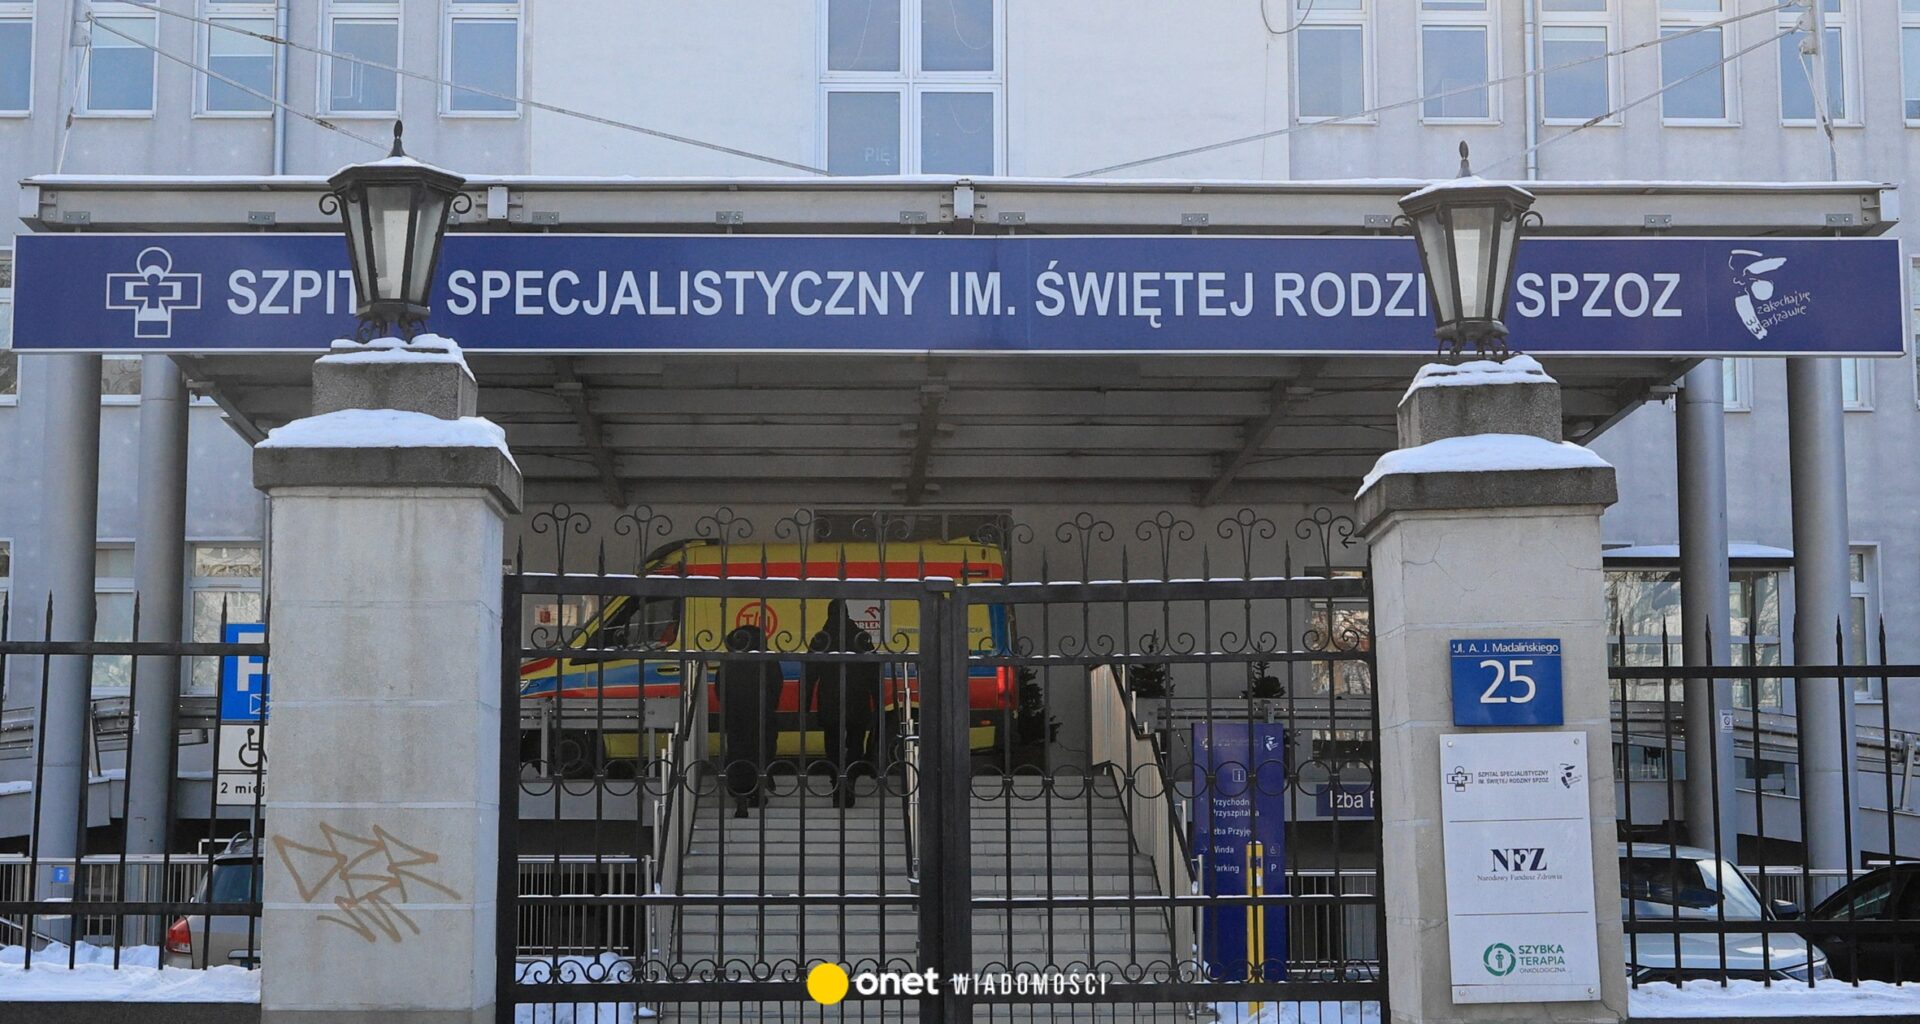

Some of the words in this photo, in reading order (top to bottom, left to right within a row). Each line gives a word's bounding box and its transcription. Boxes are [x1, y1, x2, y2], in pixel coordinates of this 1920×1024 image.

[227, 269, 358, 316] SZPIT
[446, 269, 924, 317] SPECJALISTYCZNY
[950, 270, 1016, 316] IM.
[1035, 260, 1255, 329] ŚWIĘTEJ
[1274, 271, 1428, 318] RODZI
[1515, 271, 1683, 318] SPZOZ
[1469, 643, 1480, 653] A.
[1483, 643, 1490, 653] J.
[1492, 642, 1559, 655] Madalińskiego
[1479, 659, 1536, 704] 25
[219, 781, 229, 794] 2
[1329, 790, 1364, 808] Izba
[1213, 809, 1260, 818] rzyszpitala
[1214, 827, 1227, 836] zba
[1228, 827, 1251, 837] Przyję
[1490, 848, 1548, 872] NFZ
[1214, 864, 1240, 874] arking
[1271, 863, 1277, 872] P
[1477, 874, 1508, 882] Narodowy
[1518, 944, 1565, 955] SZYBKA
[1519, 956, 1566, 966] TERAPIA
